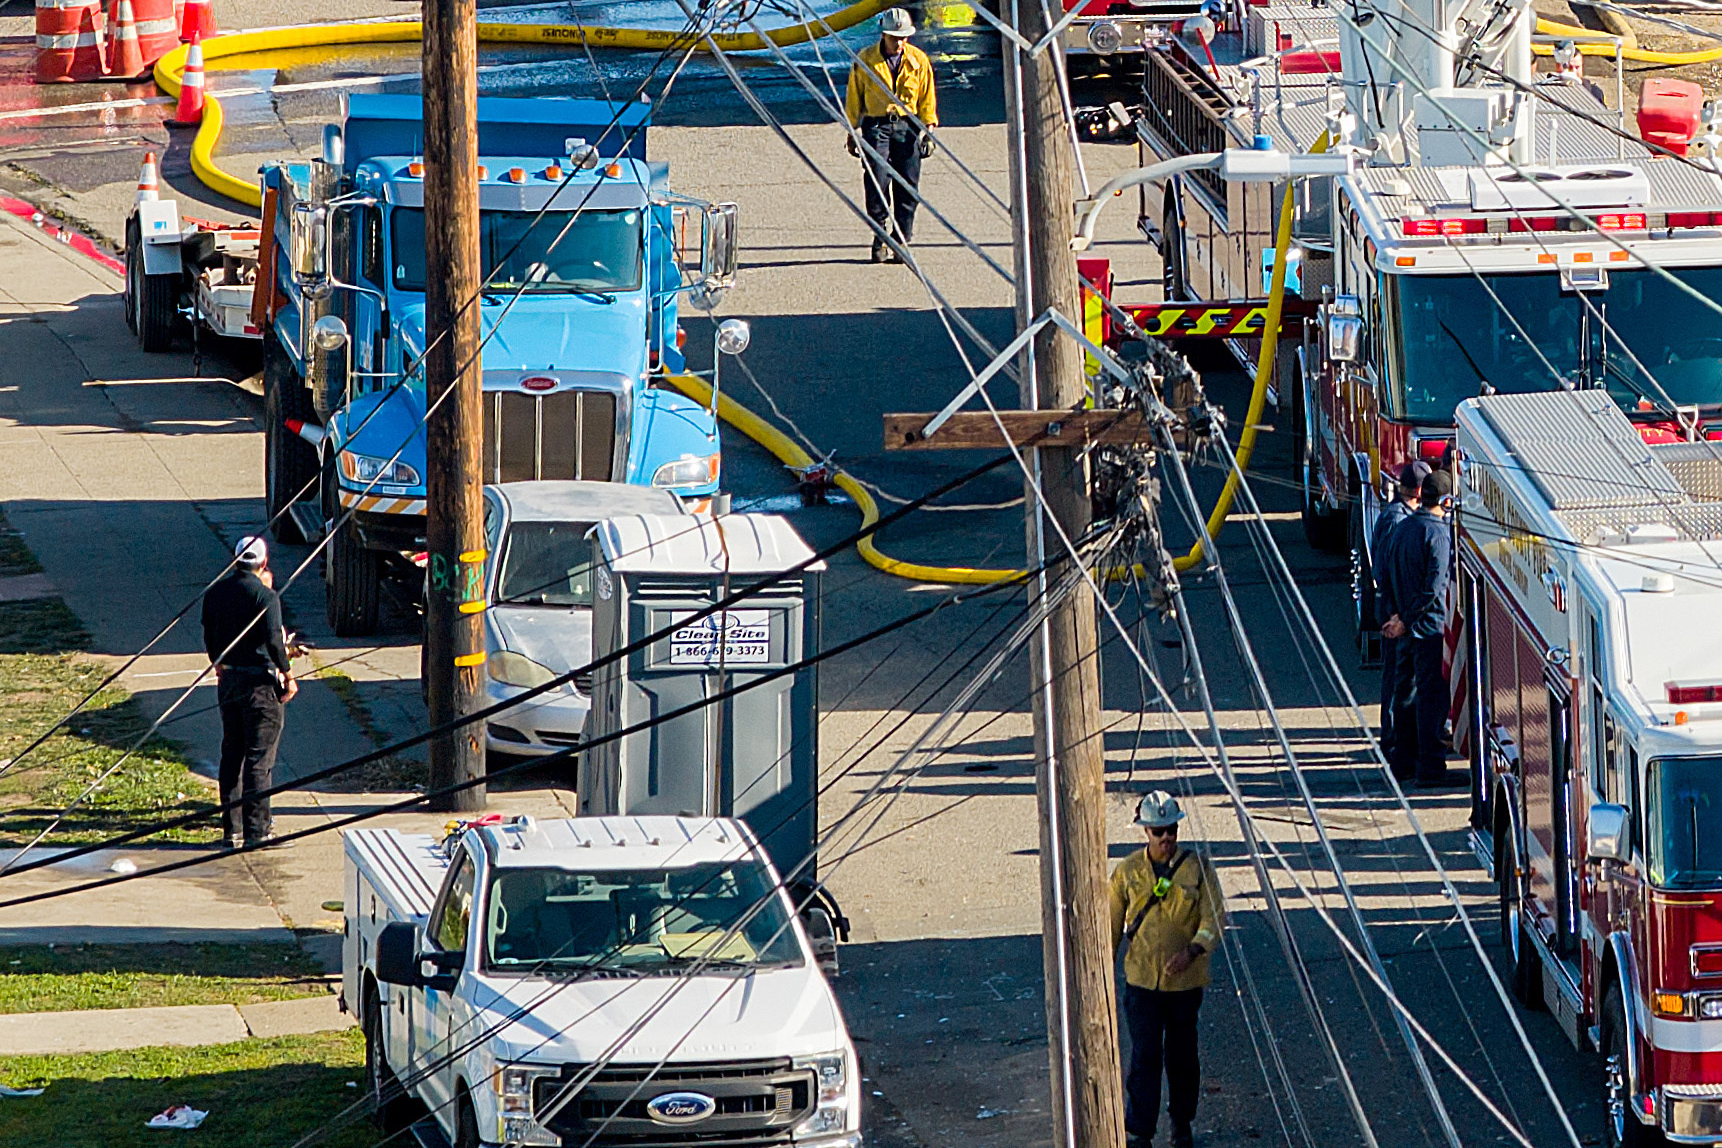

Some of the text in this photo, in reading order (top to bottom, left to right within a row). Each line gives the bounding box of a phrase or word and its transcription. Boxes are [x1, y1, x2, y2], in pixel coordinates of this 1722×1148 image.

[729, 629, 765, 640] Site
[675, 645, 765, 657] 1-866-69-3373
[665, 1101, 698, 1115] Ford
